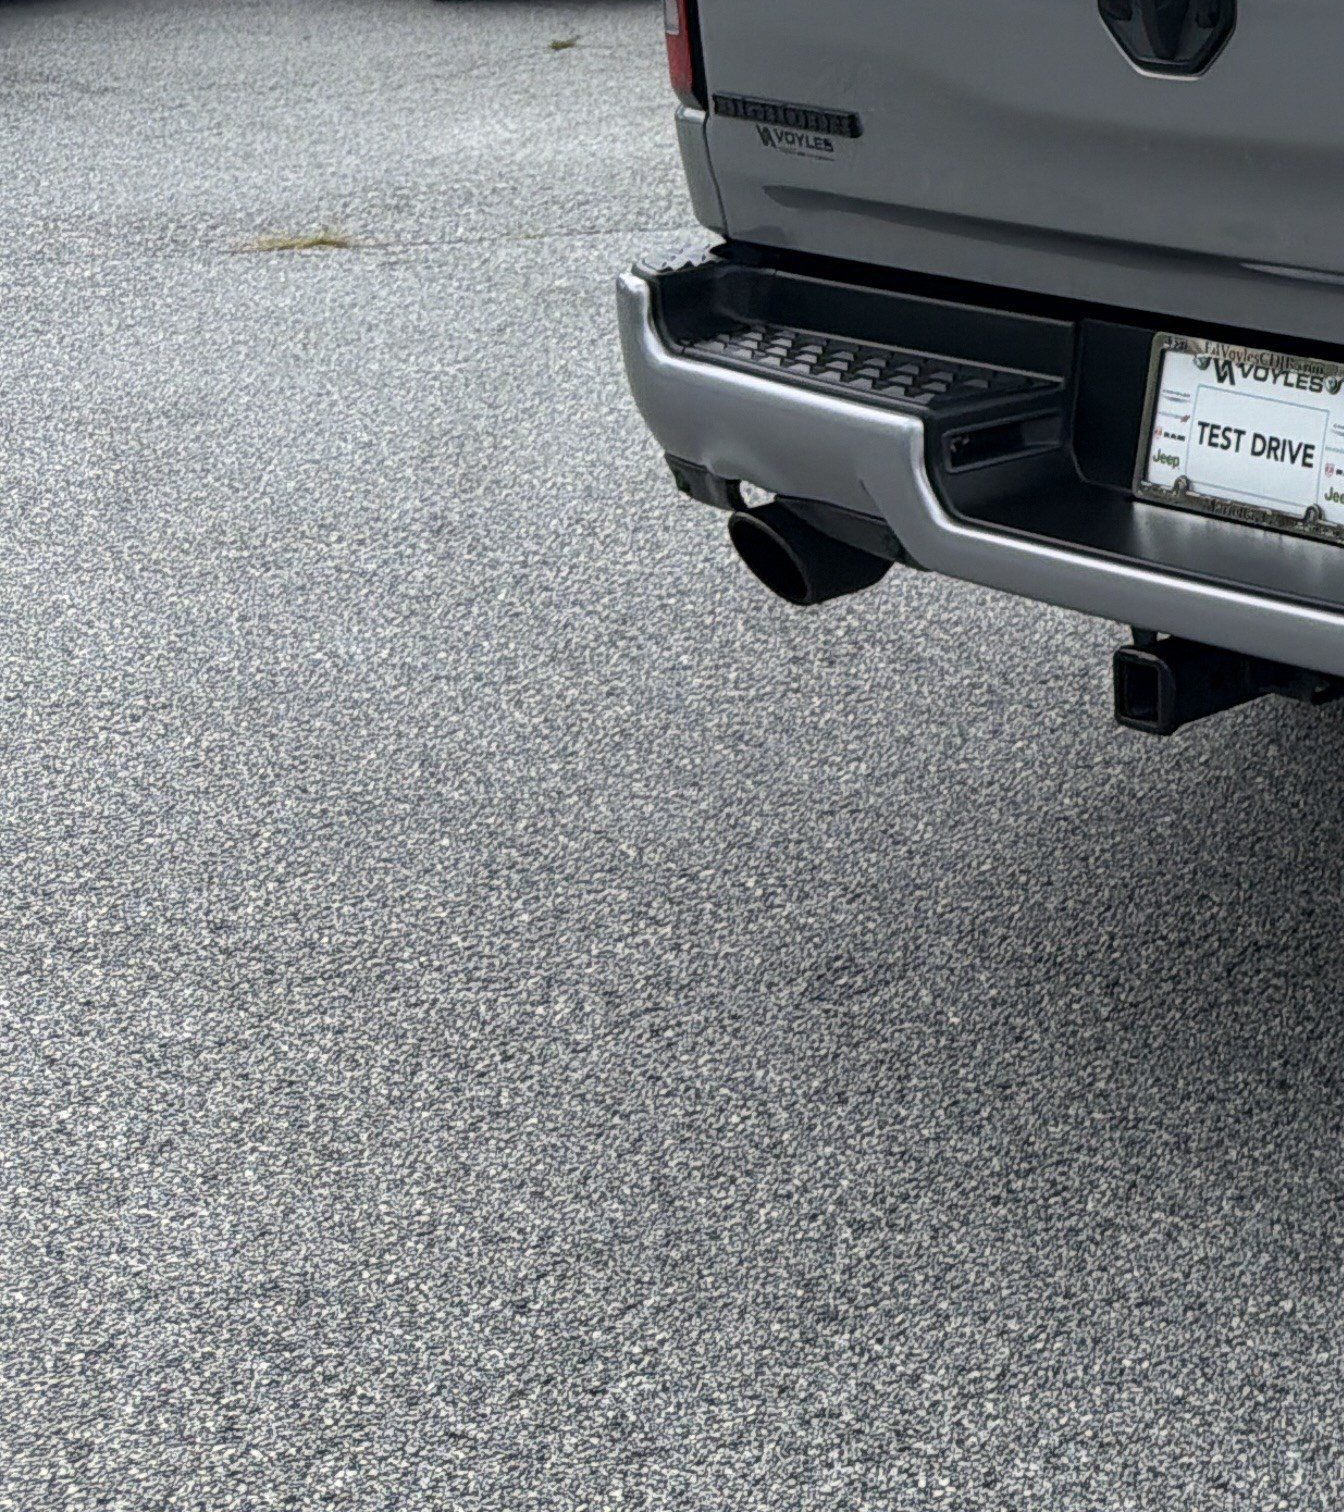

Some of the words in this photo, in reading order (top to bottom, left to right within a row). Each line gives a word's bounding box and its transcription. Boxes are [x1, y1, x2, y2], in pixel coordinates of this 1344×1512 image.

[1237, 362, 1324, 393] VOYLES
[1152, 448, 1180, 469] Jeep
[1196, 420, 1246, 454] TEST
[1250, 432, 1316, 468] DRIVE
